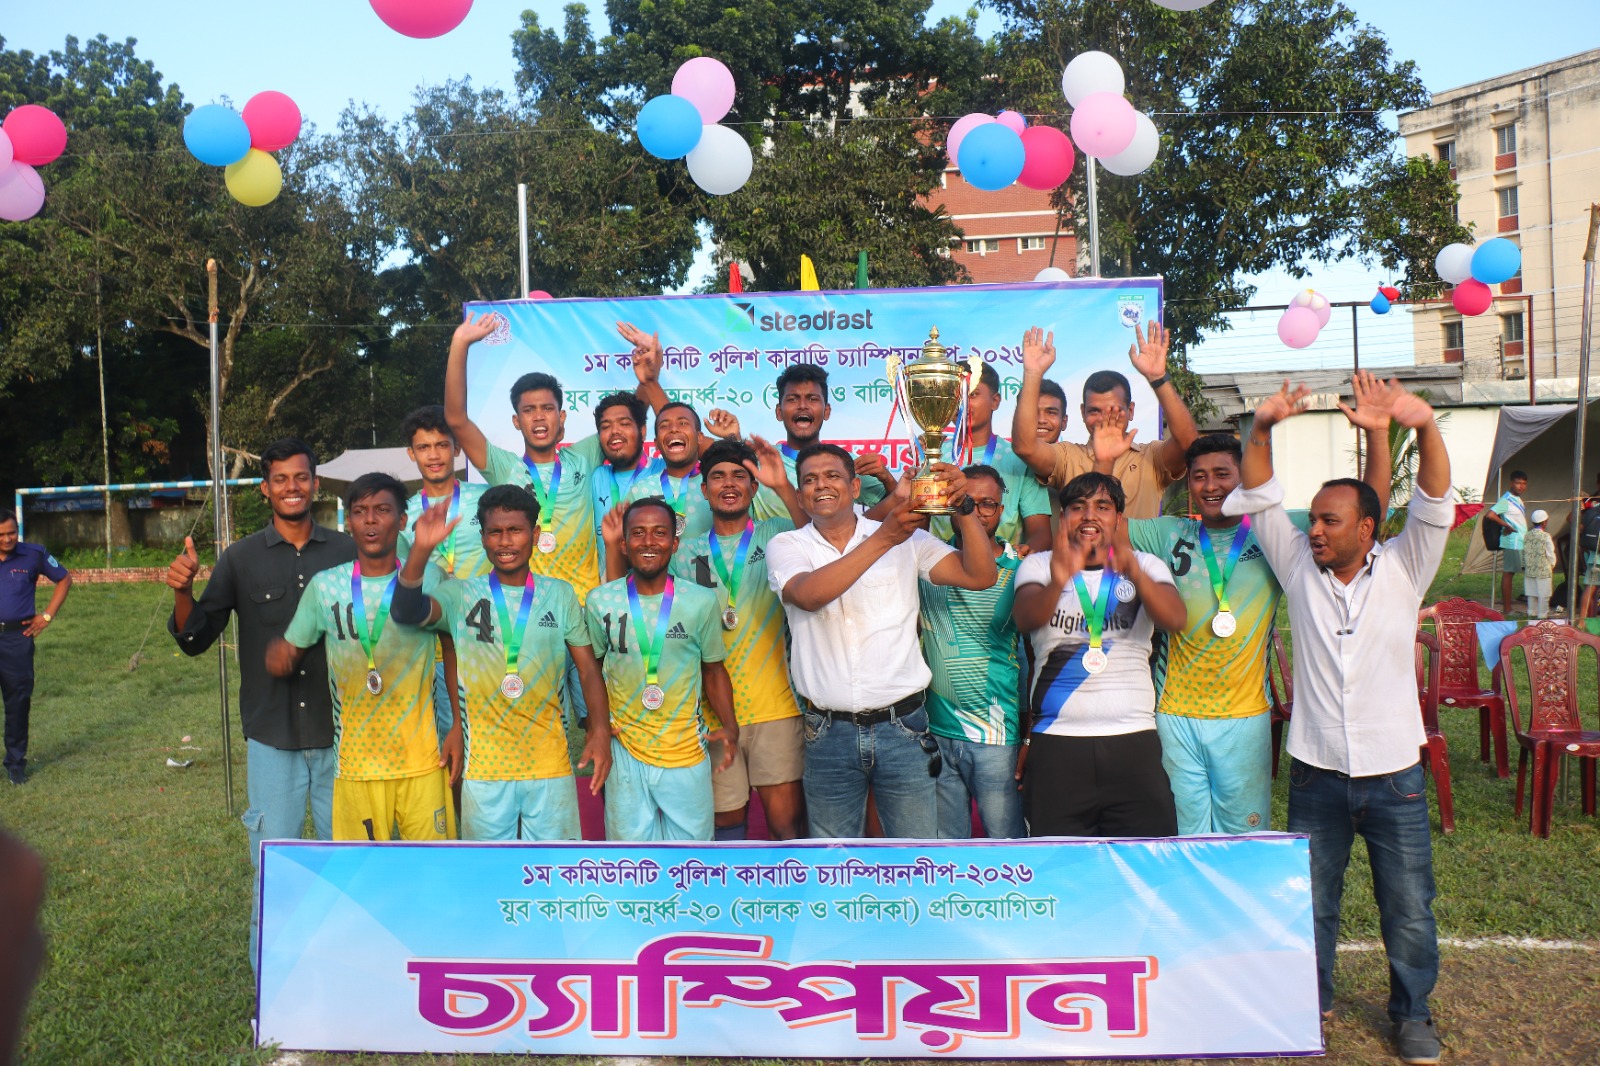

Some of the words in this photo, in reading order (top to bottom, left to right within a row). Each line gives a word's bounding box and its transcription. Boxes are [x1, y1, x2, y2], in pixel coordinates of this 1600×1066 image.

[760, 308, 874, 332] steadfast
[584, 353, 609, 372] ১ম
[614, 346, 702, 372] কনিটি
[708, 345, 761, 374] পুলিশ
[765, 343, 831, 369] কাবাডি
[564, 389, 592, 412] যুব
[831, 386, 846, 402] ও
[691, 555, 718, 588] 1
[1170, 537, 1195, 576] 5
[465, 598, 495, 644] 4
[538, 620, 559, 629] adidas
[602, 612, 629, 654] 11
[665, 631, 689, 639] adidas
[523, 865, 553, 886] ১ম
[558, 858, 661, 886] কমিউনিটি
[668, 859, 728, 891] পুলিশ
[733, 858, 809, 886] কাবাডি
[815, 856, 1033, 887] চ্যাম্পিয়নশীপ-২০২৬
[498, 899, 532, 924] যুব
[537, 893, 610, 921] কাবাডি
[731, 898, 802, 926] (বালক
[809, 901, 828, 919] ও
[834, 893, 919, 926] বালিকা)
[928, 892, 1057, 920] প্রতিযোগিতা
[407, 931, 1158, 1053] চ্যাম্পিয়ন
